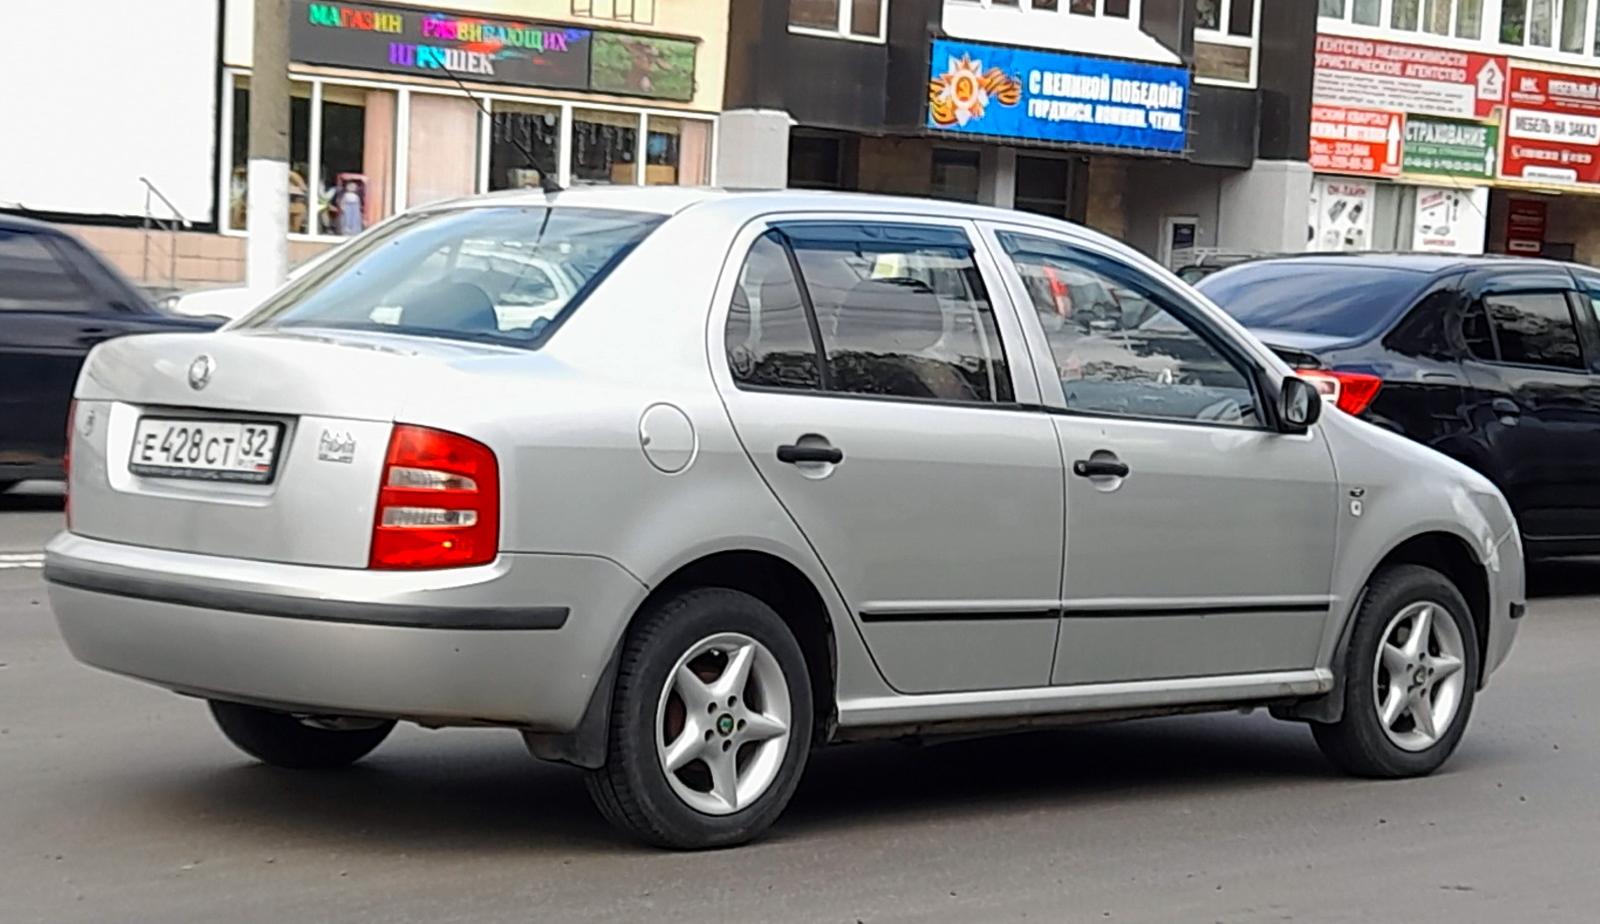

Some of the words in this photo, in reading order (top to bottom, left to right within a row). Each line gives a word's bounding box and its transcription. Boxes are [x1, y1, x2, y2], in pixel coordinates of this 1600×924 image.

[309, 3, 402, 34] МАГАЗИН
[422, 17, 568, 52] РАЗВИВАЮЩИХ
[389, 42, 495, 75] ИГРУШЕК
[1315, 36, 1373, 57] ГЕНТСТВО
[1375, 43, 1468, 67] НЕДВИЖИМОСТИ
[1315, 53, 1402, 77] УРИСТИЧЕСКОЕ
[1404, 62, 1467, 83] АГЕНТСТВО
[1485, 67, 1496, 87] 2
[1028, 69, 1042, 95] С
[1042, 71, 1111, 101] ВЕЛИКОЙ
[1111, 78, 1184, 110] ПОБЕДОЙ!
[1405, 120, 1488, 148] СТРАХОВАНИЕ
[1515, 116, 1551, 134] МЕБЕЛЬ
[1553, 119, 1566, 135] НА
[1568, 121, 1598, 139] ЗАКАЗ
[241, 427, 269, 458] 32
